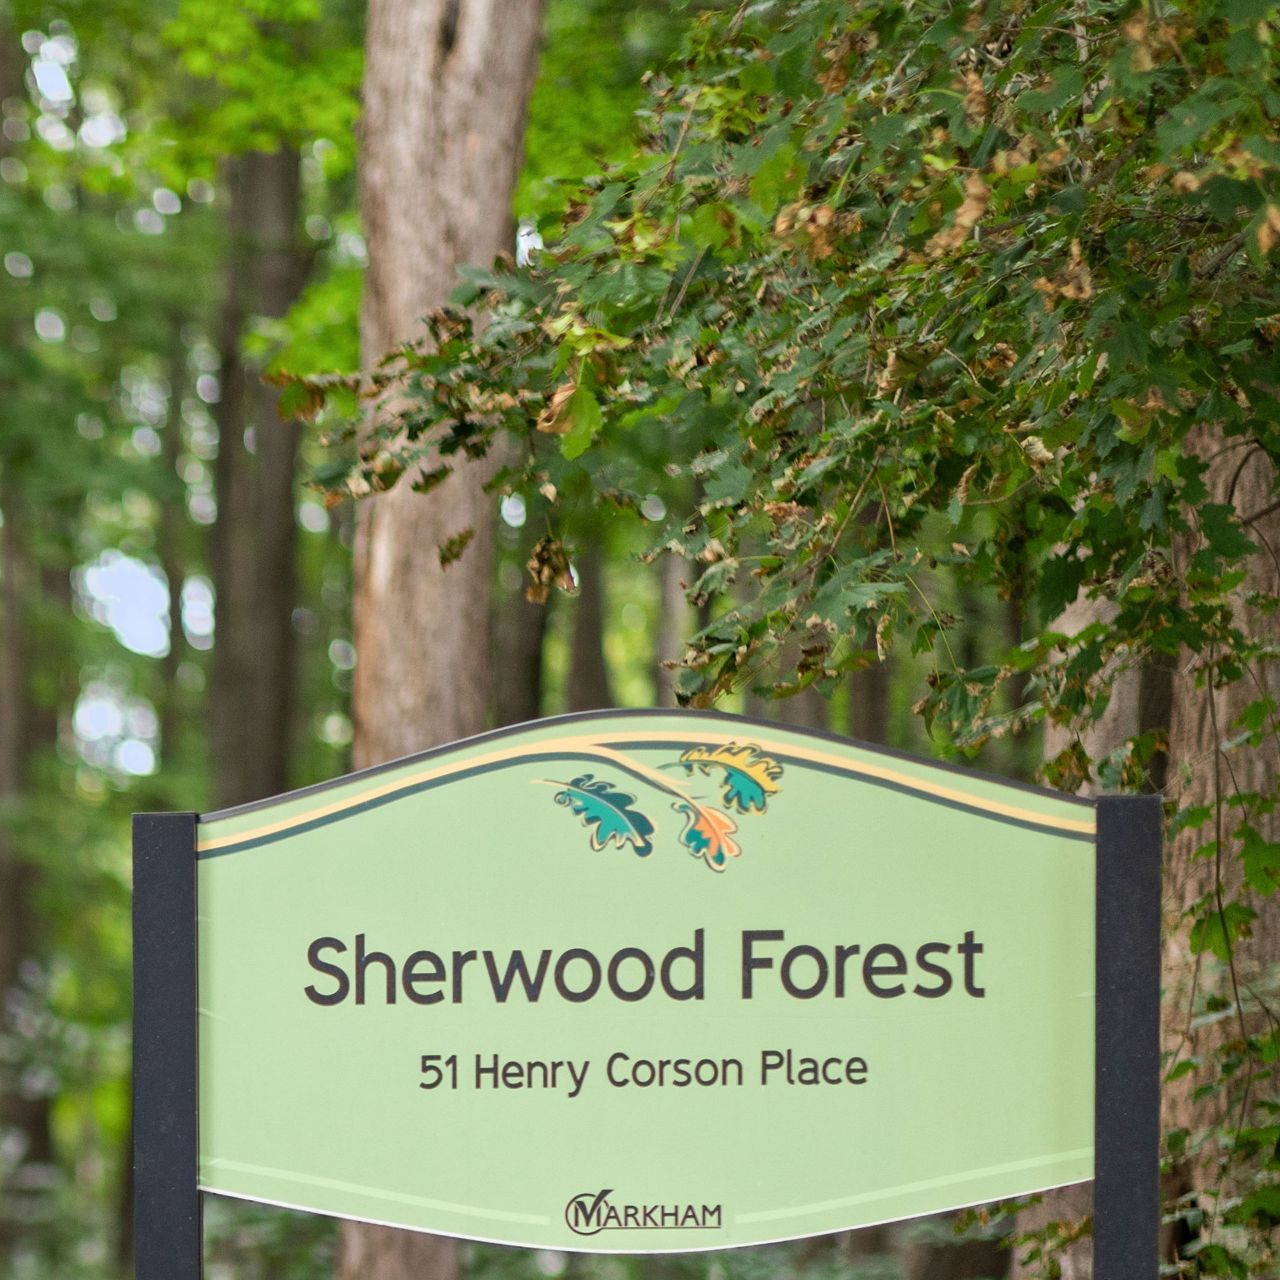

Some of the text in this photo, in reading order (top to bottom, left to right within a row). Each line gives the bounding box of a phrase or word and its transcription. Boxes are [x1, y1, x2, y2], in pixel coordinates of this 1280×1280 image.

[304, 928, 985, 1006] Sherwood Forest
[419, 1049, 868, 1098] 51 Henry Corson Place
[565, 1189, 722, 1236] MARKHAM
